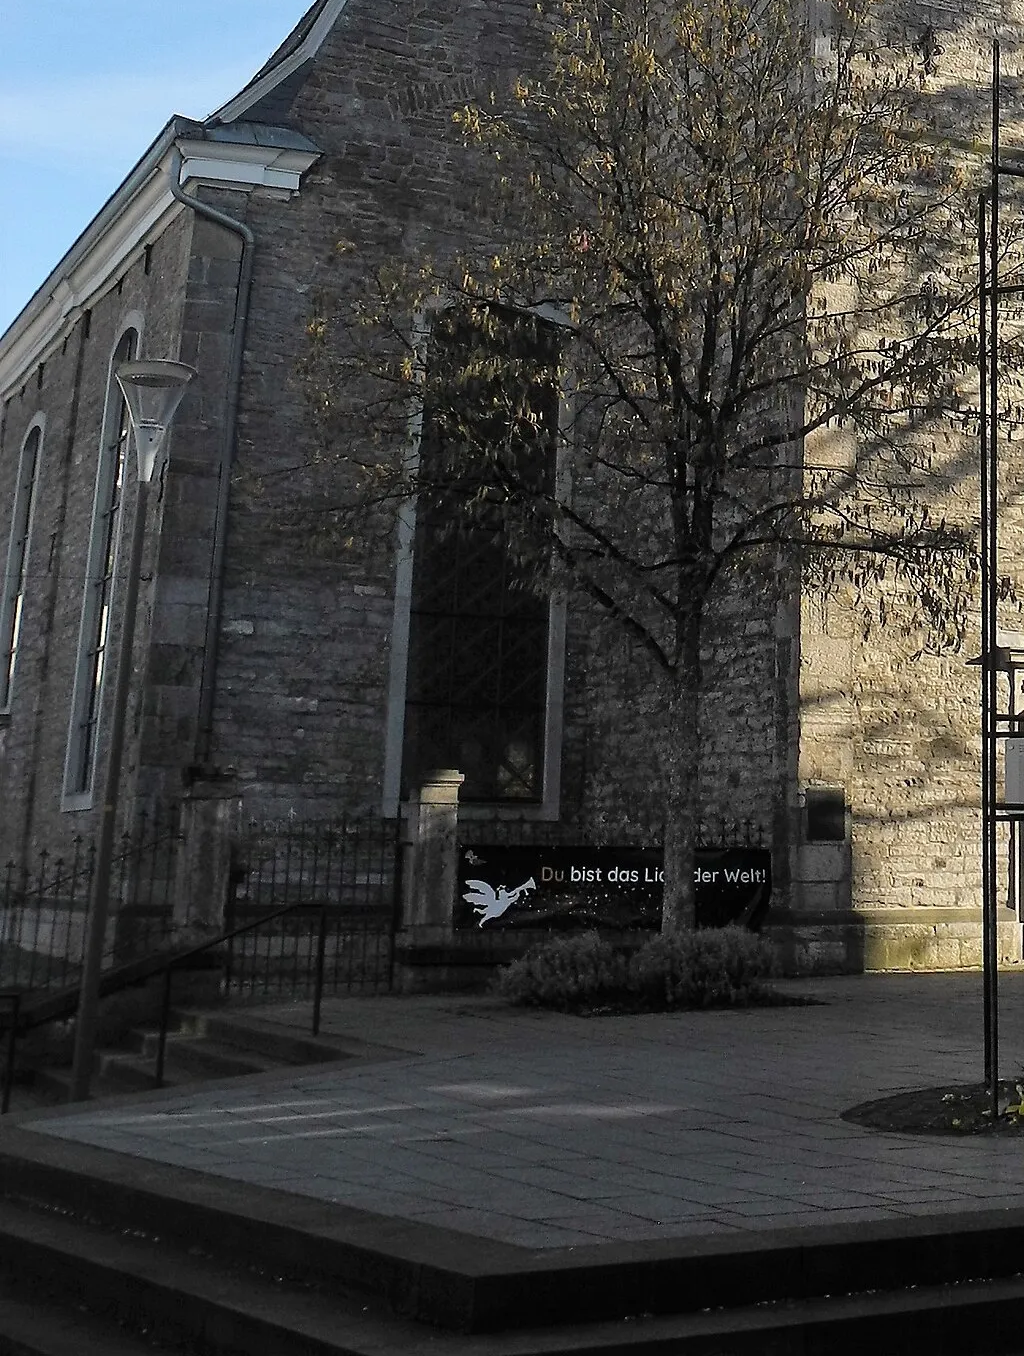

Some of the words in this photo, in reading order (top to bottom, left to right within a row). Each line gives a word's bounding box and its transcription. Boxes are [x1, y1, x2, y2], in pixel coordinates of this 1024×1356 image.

[541, 866, 565, 882] Du
[570, 866, 602, 882] bist
[607, 866, 639, 882] das
[644, 866, 665, 882] Lic
[723, 868, 766, 883] Welt!
